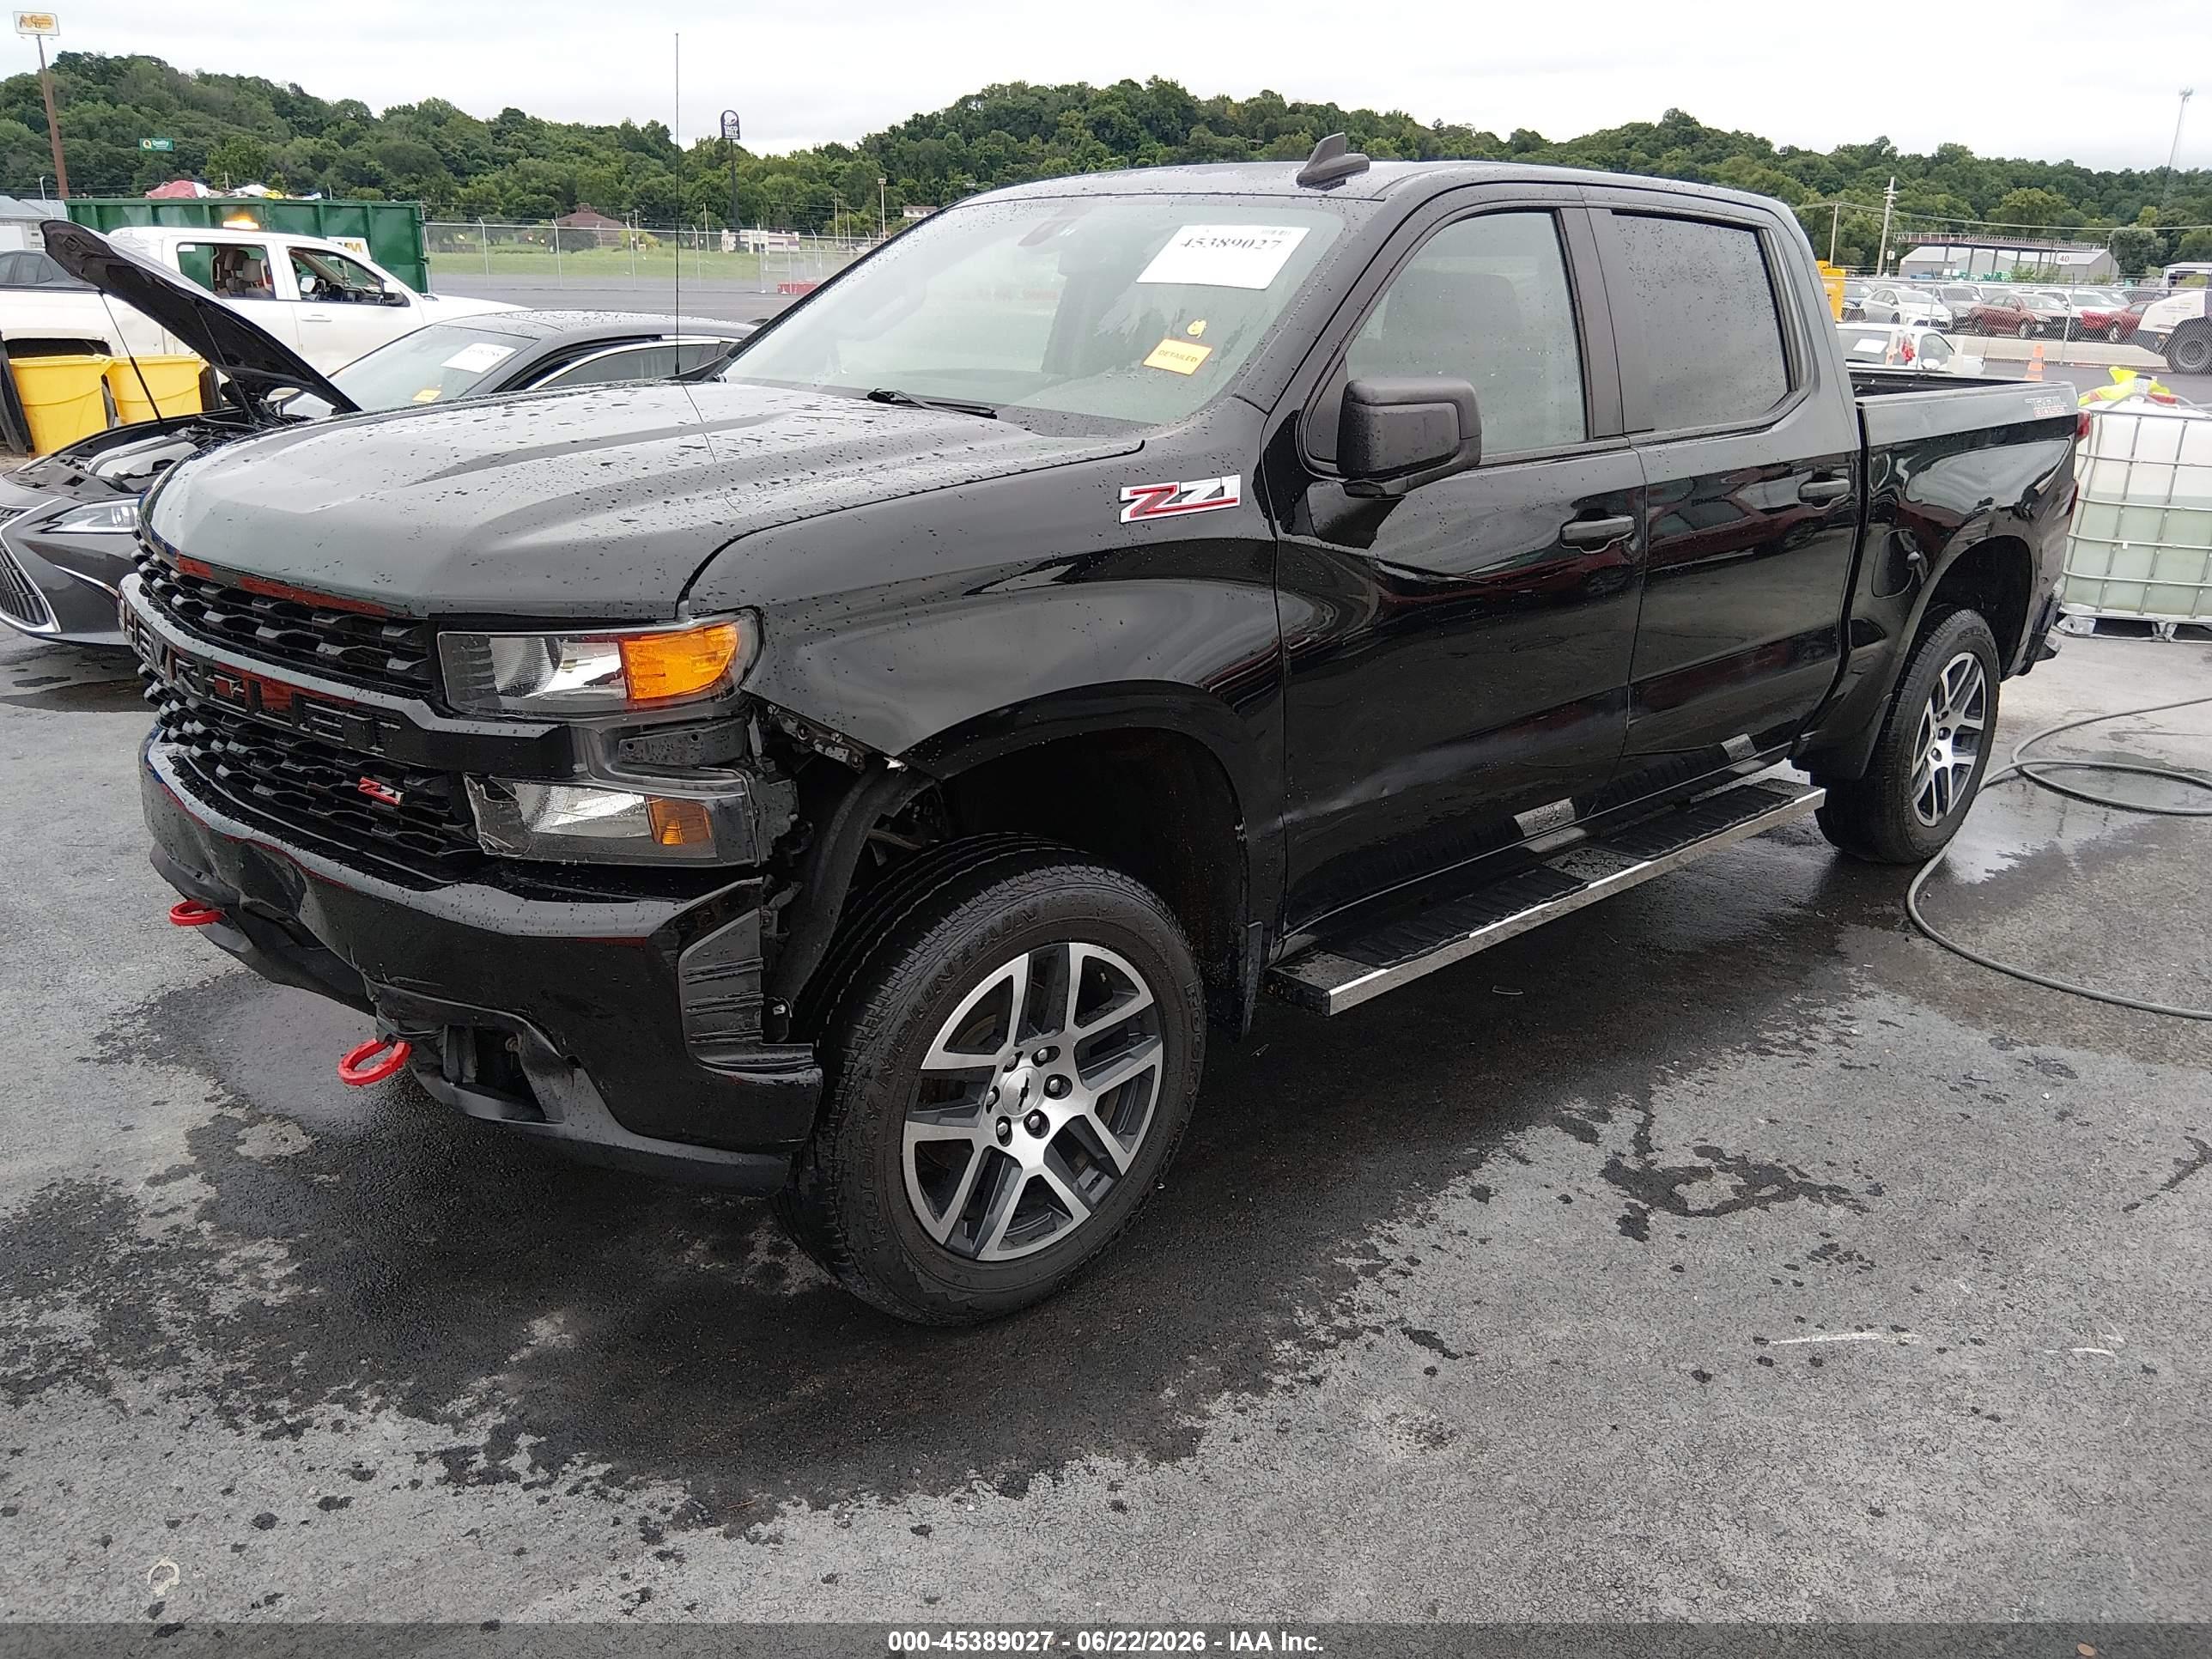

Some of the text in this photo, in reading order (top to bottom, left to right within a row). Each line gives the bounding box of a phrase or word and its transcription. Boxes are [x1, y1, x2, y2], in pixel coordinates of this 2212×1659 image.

[1180, 237, 1283, 250] 45389027
[1158, 349, 1199, 363] DETAILED
[2025, 395, 2069, 409] TRAIL
[1119, 474, 1242, 524] Z71
[357, 776, 404, 806] Z71
